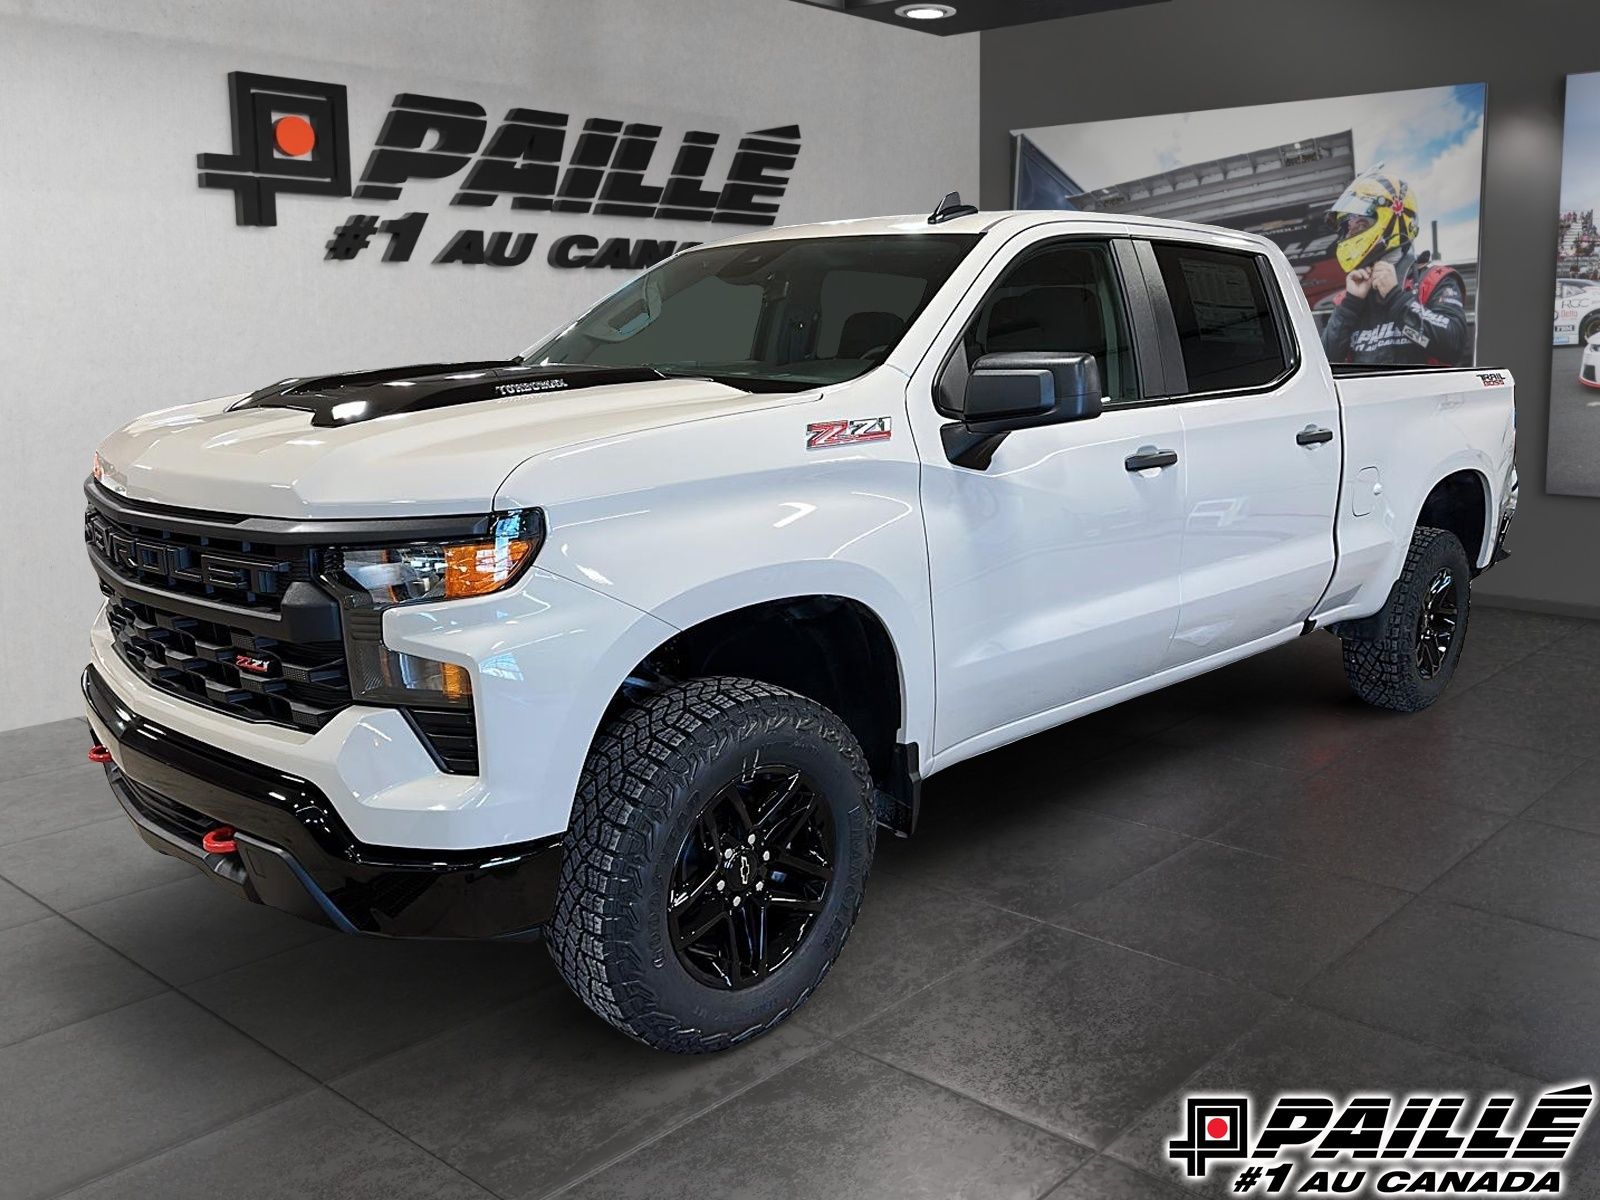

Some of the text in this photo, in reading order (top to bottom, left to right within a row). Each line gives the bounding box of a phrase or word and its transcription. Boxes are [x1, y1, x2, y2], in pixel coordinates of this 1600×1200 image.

[352, 93, 801, 226] PAILLÉ
[324, 212, 704, 270] #1 AU CAN
[805, 416, 892, 450] Z71
